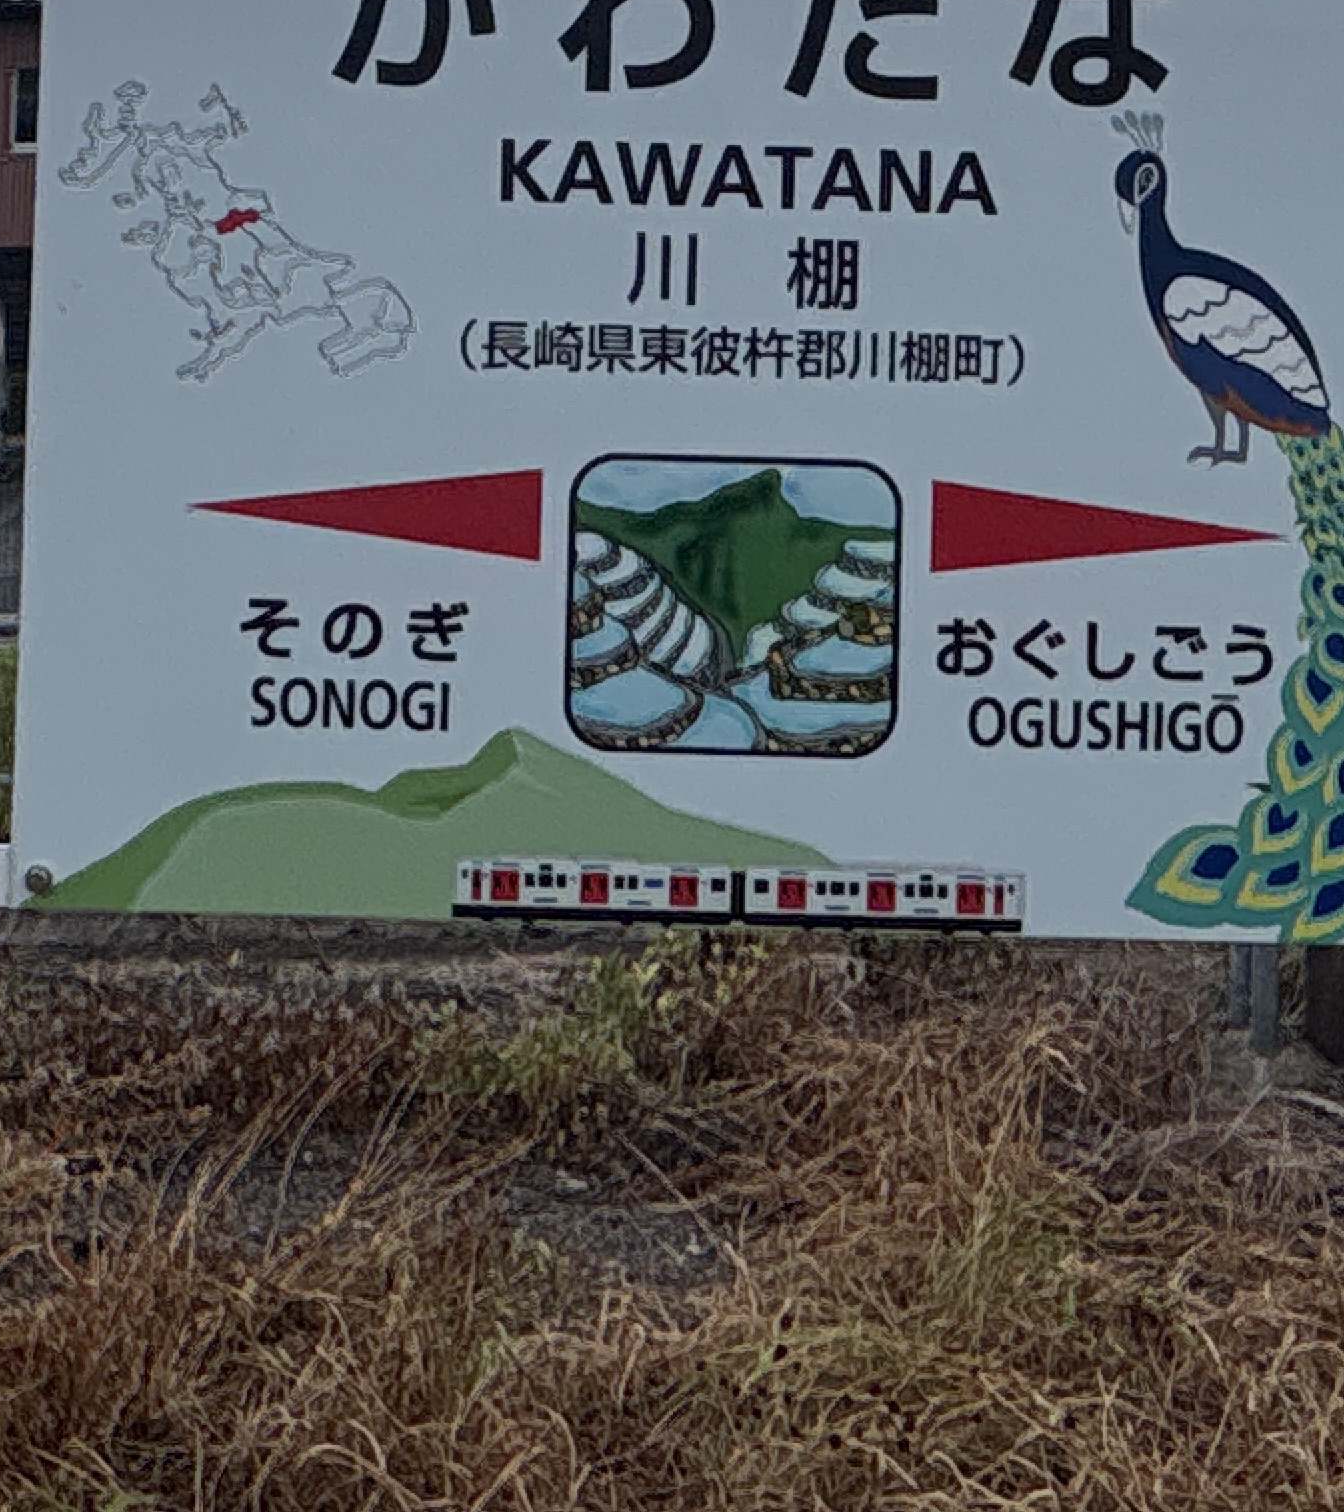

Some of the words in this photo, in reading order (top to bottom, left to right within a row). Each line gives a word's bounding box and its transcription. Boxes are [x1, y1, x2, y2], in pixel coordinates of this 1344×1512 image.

[500, 138, 998, 216] KAWATANA
[626, 232, 860, 310] 川棚
[459, 318, 1026, 386] （長崎県東彼杵郡川棚町）
[240, 598, 470, 662] そのぎ
[935, 617, 1275, 685] おぐしごう
[250, 676, 450, 732] SONOGI
[968, 694, 1244, 754] OGUSHIGŌ
